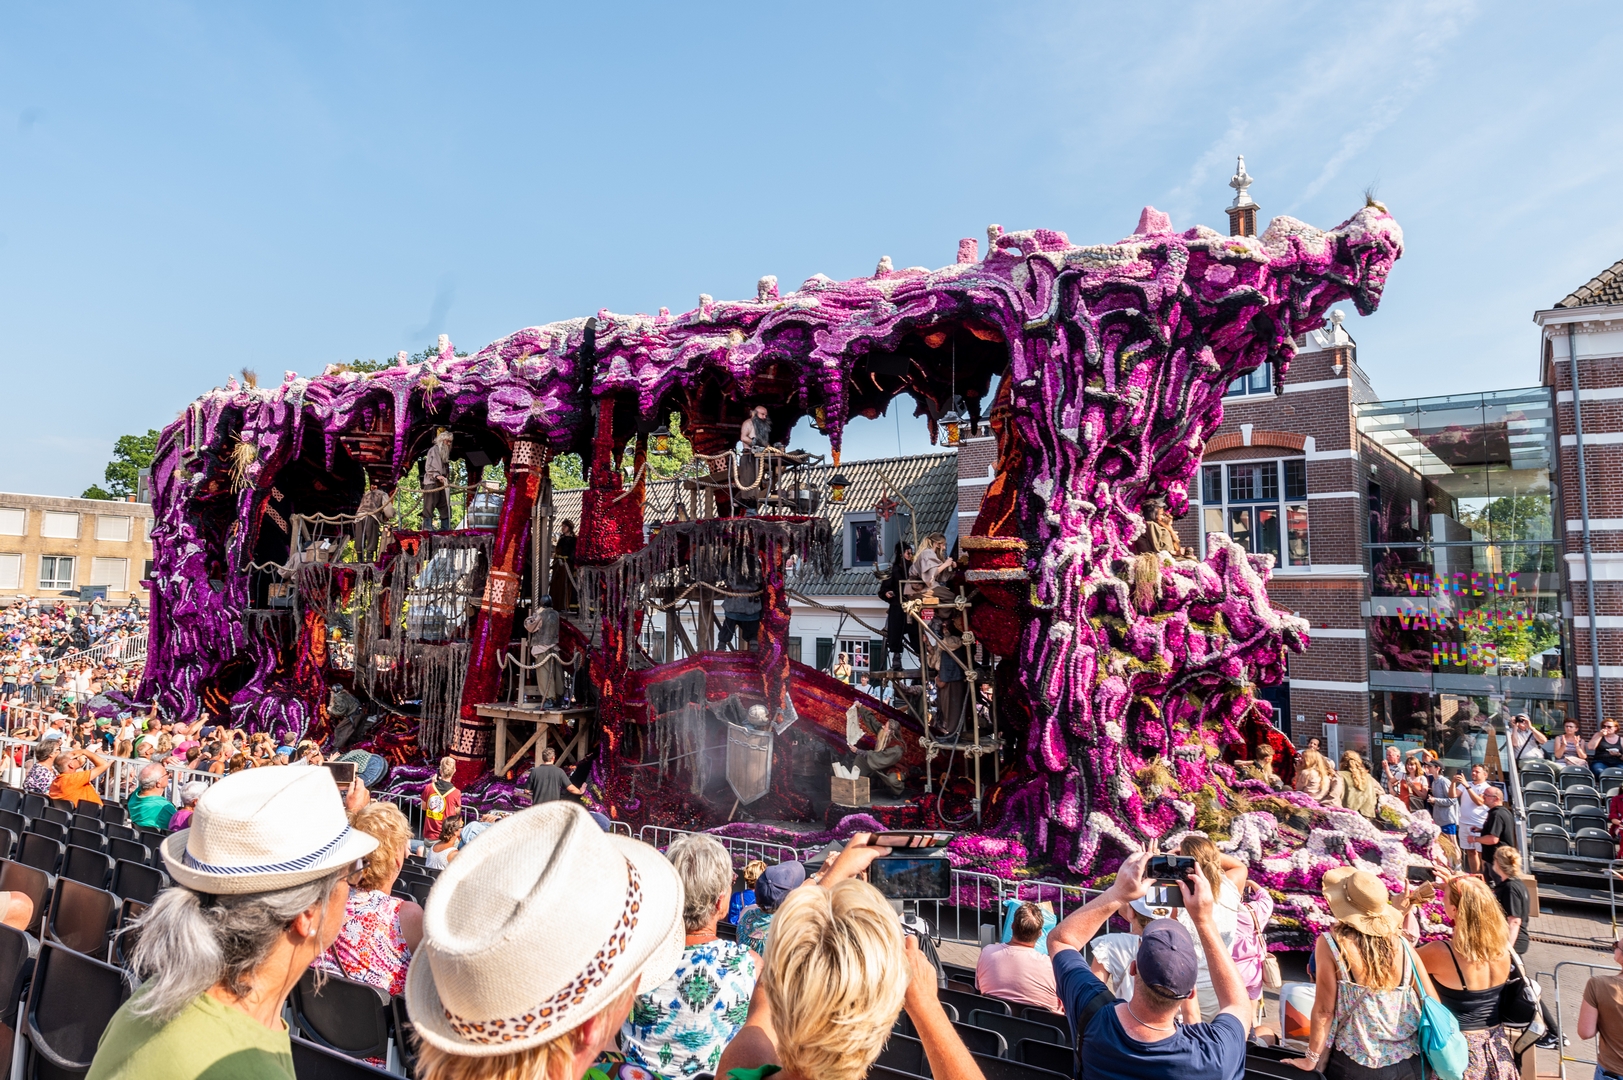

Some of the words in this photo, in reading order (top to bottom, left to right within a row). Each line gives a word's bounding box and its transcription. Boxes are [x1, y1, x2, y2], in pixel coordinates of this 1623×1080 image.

[1404, 572, 1521, 596] VINCENT
[1396, 607, 1446, 631] VAN
[1458, 607, 1533, 632] GOGH
[1432, 641, 1497, 667] HUIS
